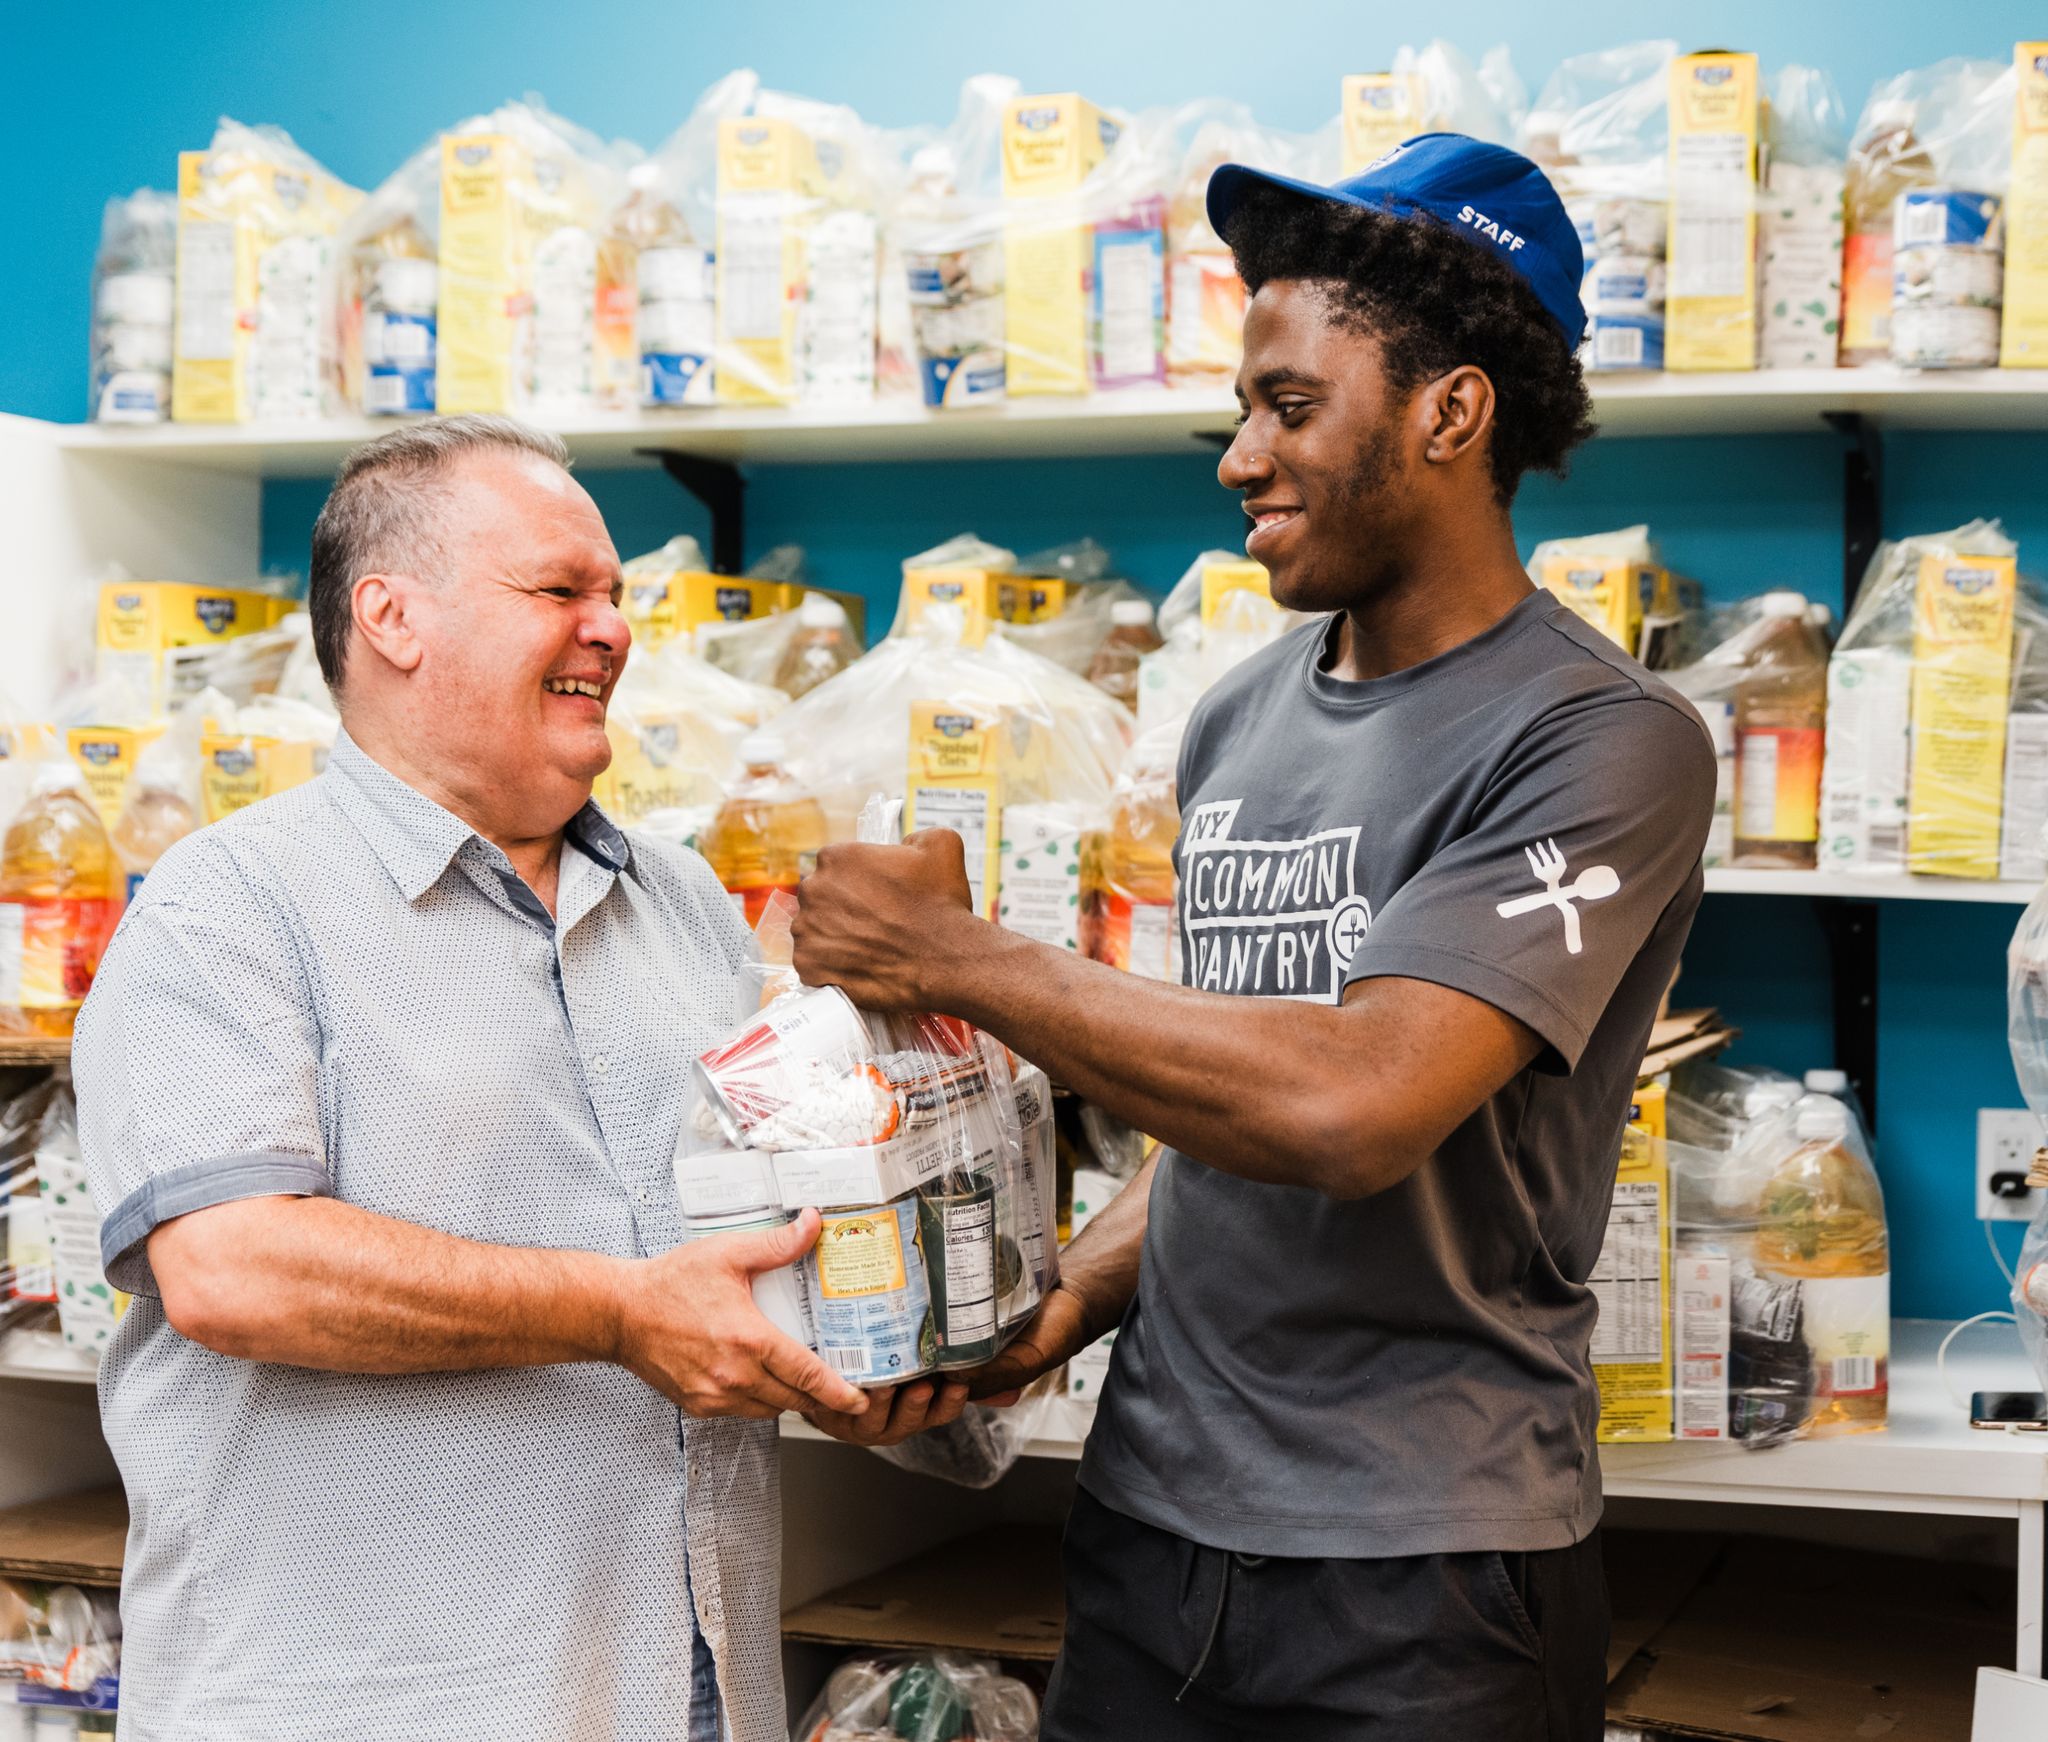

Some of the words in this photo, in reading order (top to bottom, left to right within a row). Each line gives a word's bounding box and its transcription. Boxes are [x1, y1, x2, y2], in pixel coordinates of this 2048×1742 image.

[1457, 205, 1526, 251] STAFF
[1192, 811, 1231, 841] NY
[1194, 843, 1340, 912] COMMON
[1197, 929, 1320, 991] PANTRY
[915, 1141, 963, 1175] SPHETTI
[946, 1207, 976, 1216] utrition
[946, 1234, 973, 1244] Calories
